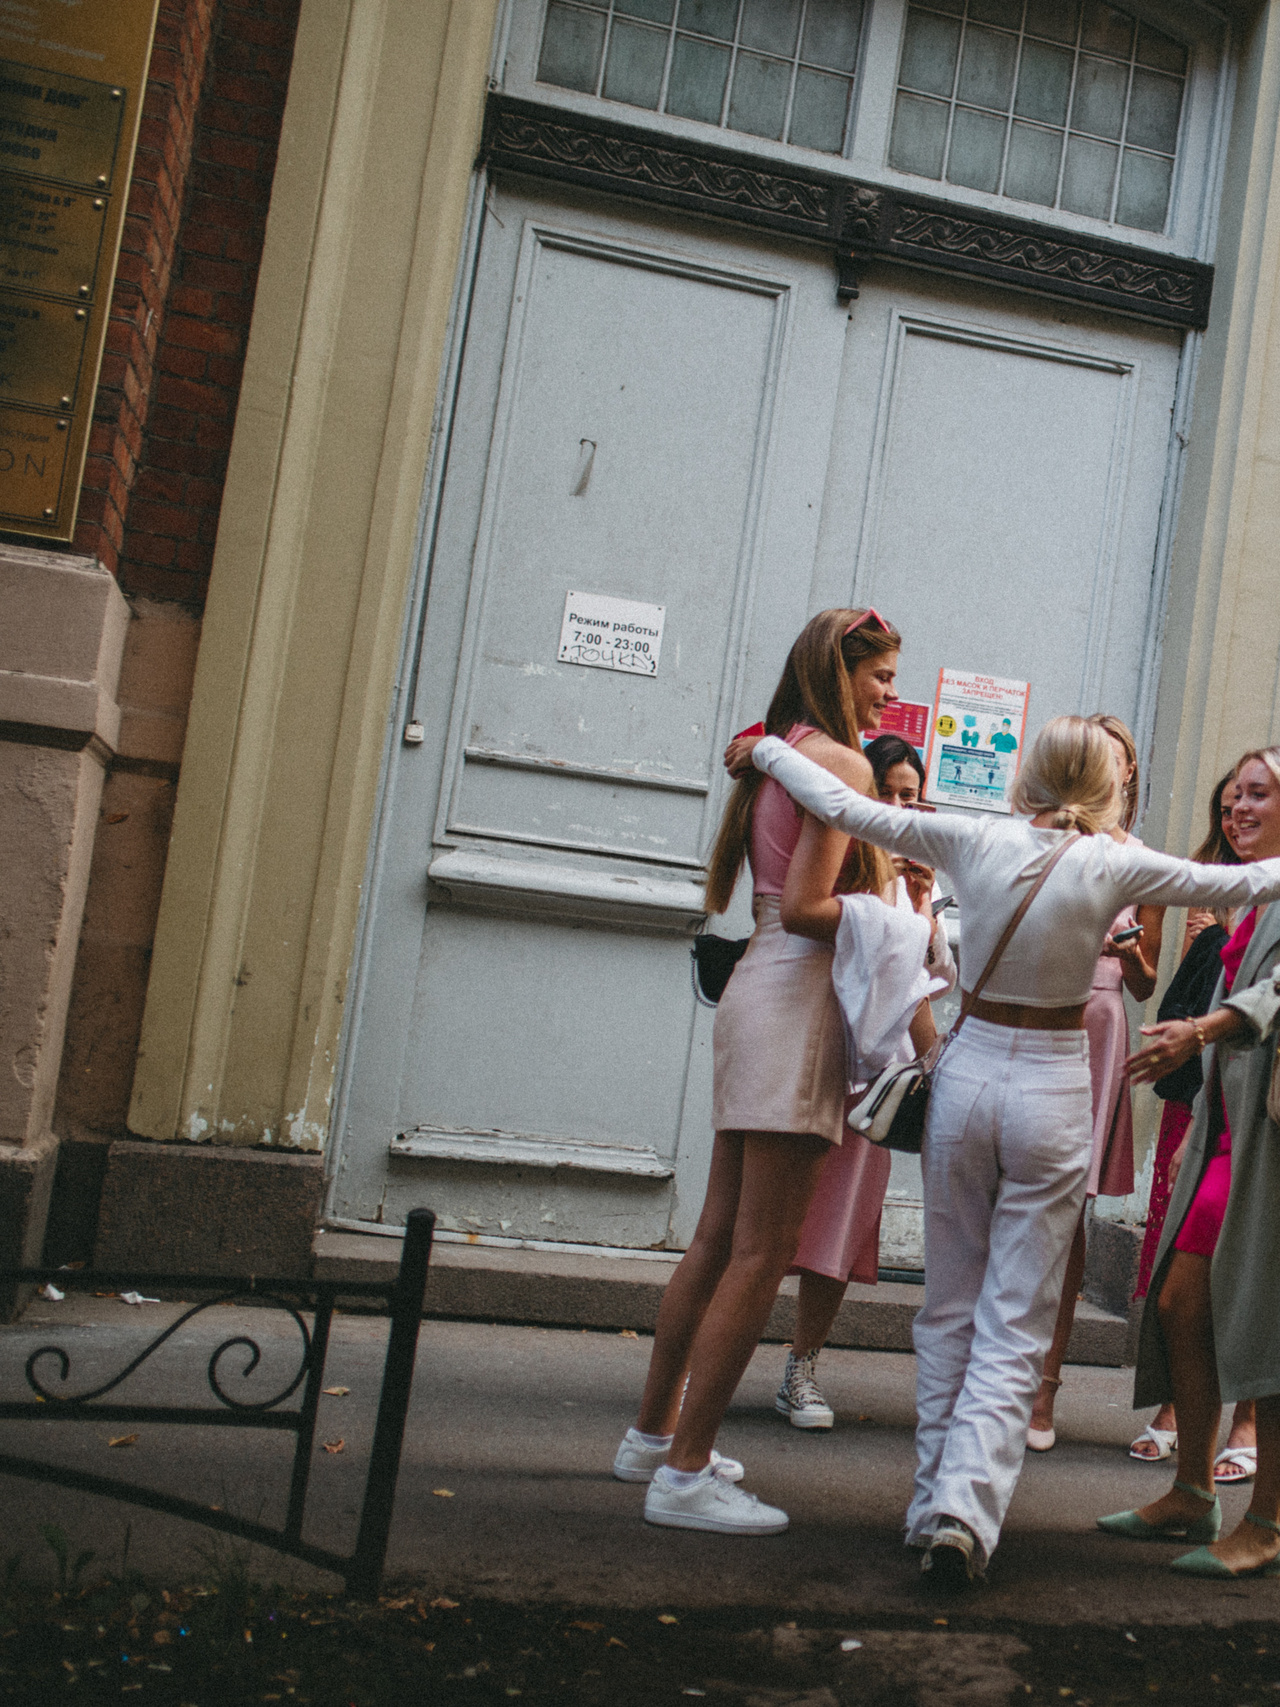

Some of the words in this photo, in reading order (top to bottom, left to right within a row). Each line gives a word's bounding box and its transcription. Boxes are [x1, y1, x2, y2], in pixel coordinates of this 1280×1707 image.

[569, 613, 609, 629] Режим
[612, 622, 659, 637] работы
[574, 631, 602, 645] 7:00
[614, 638, 650, 653] 23:00
[957, 681, 981, 690] МАСОК
[989, 686, 1026, 697] ПЕРЧАТОК
[975, 676, 994, 686] ВХОД
